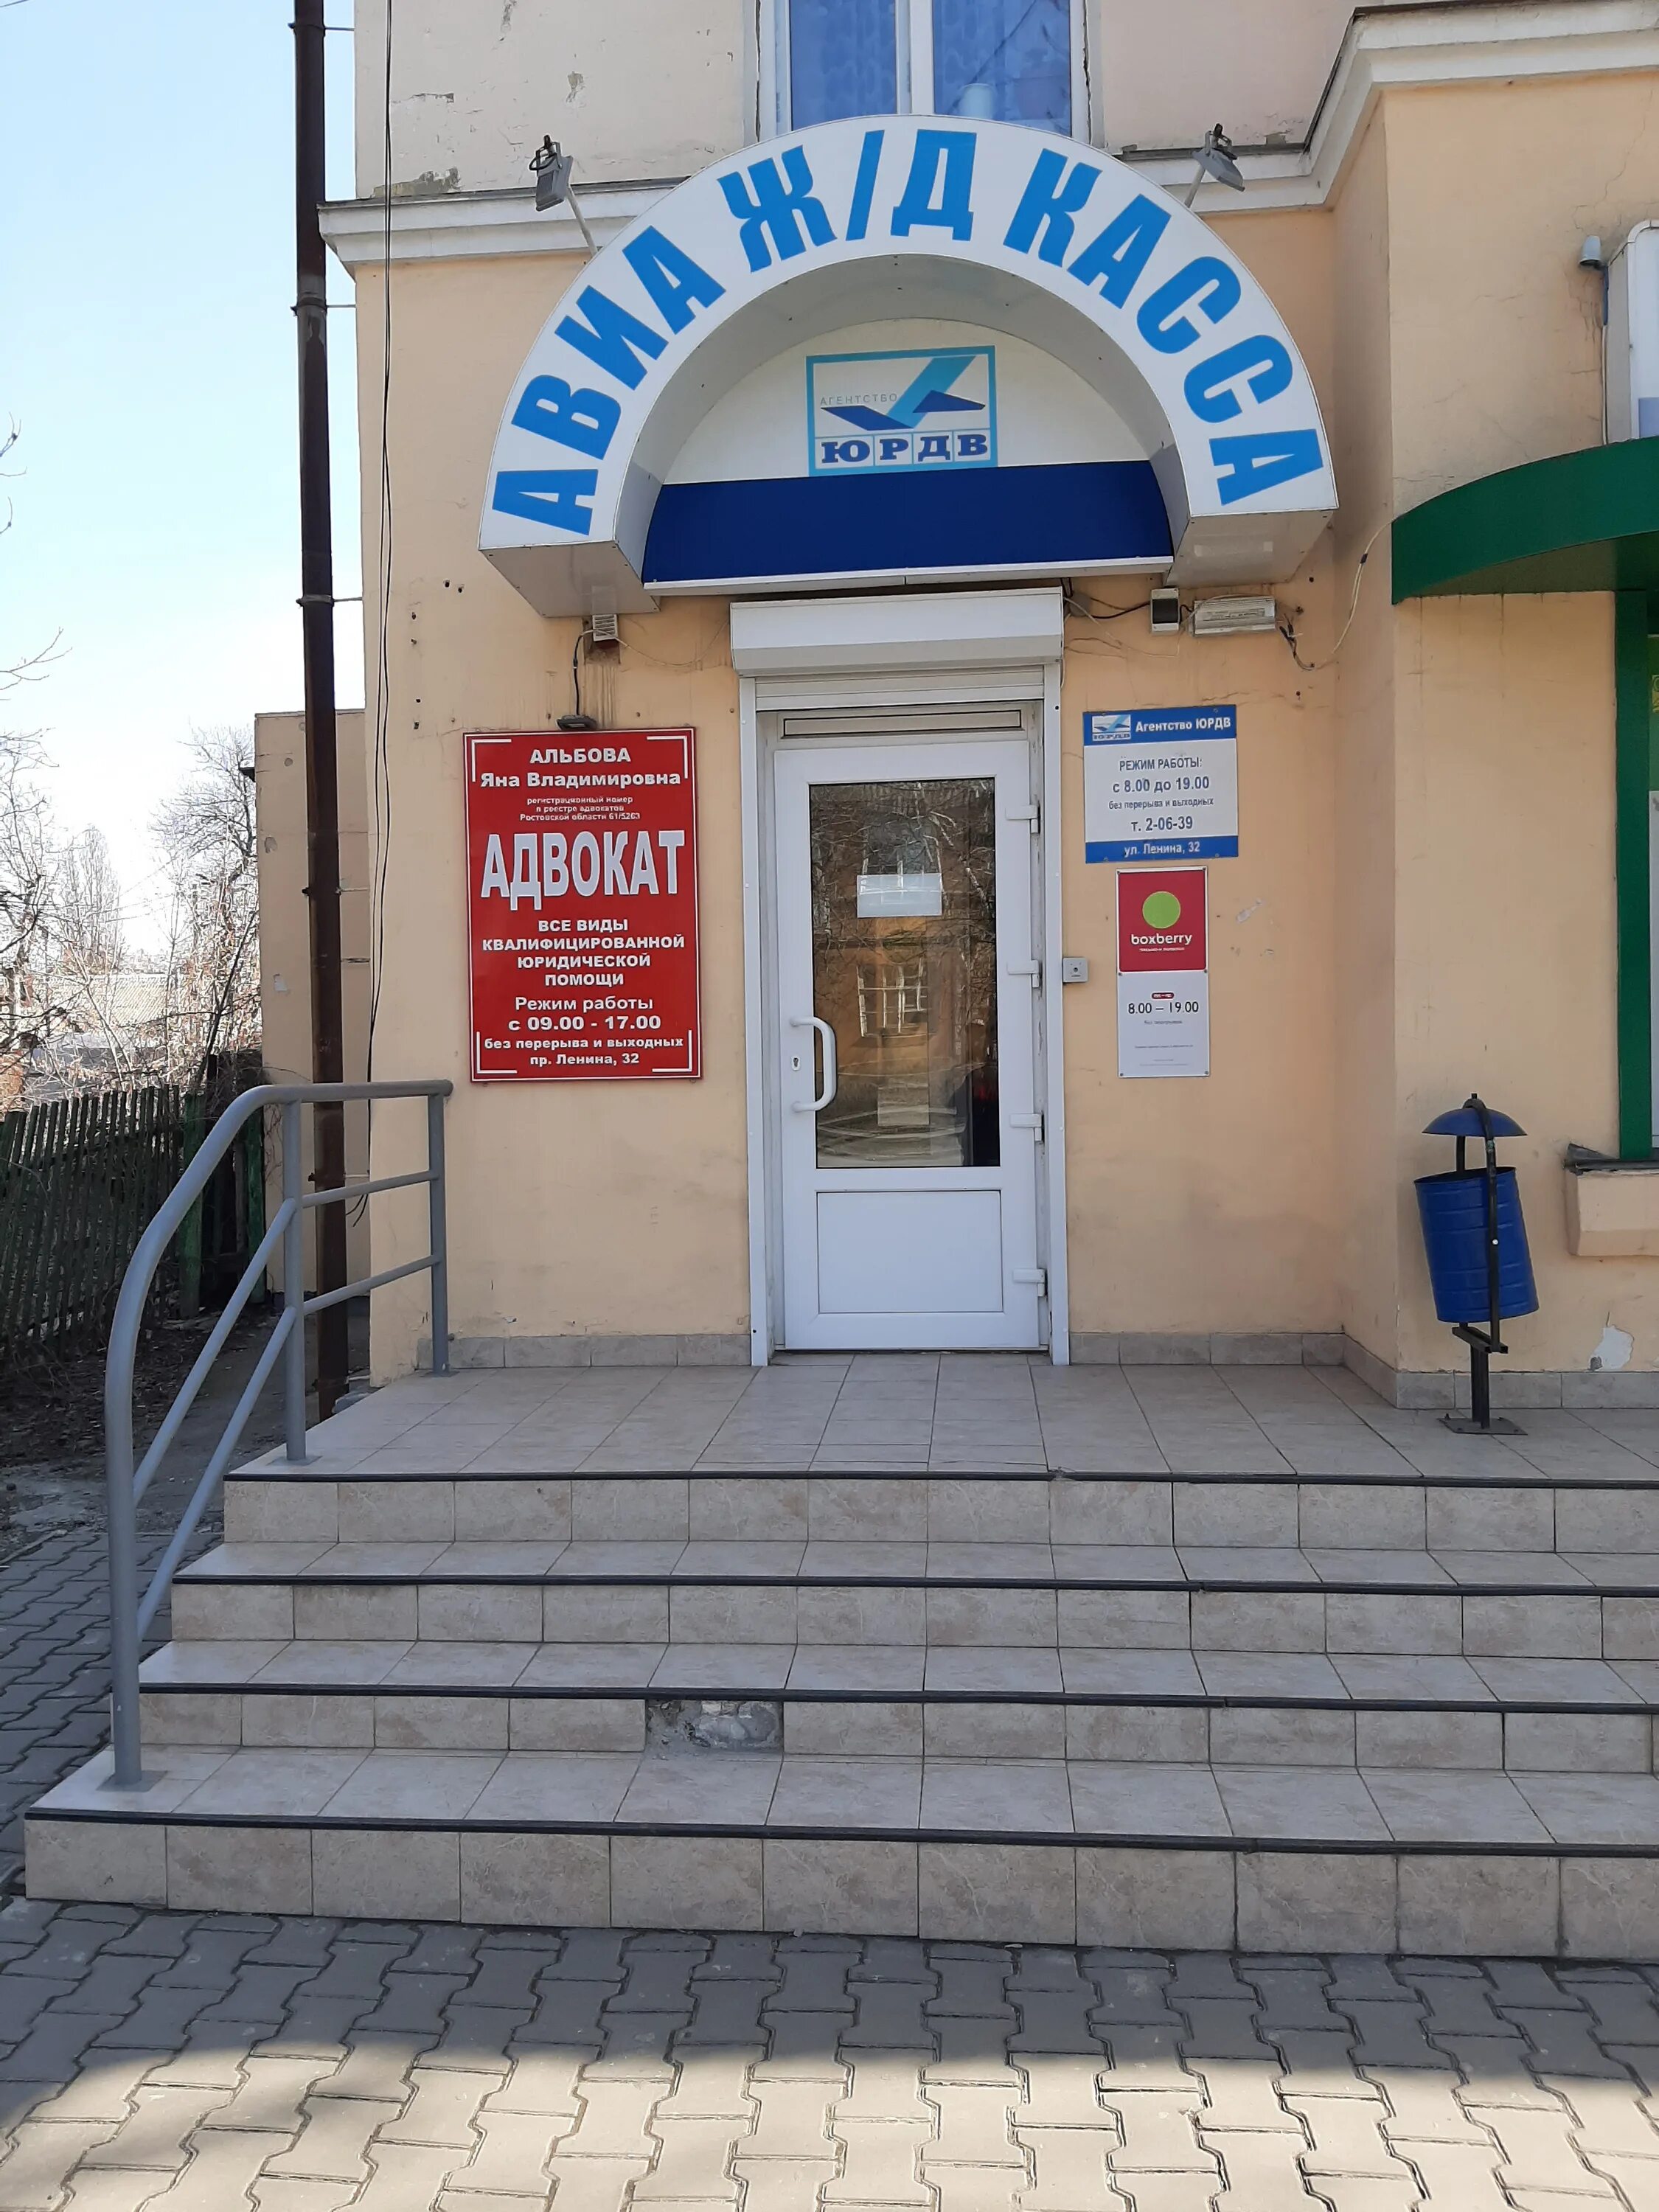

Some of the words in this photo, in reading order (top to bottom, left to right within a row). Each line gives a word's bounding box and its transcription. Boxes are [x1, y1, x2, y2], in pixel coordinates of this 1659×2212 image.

[492, 226, 726, 535] АВИА
[717, 128, 977, 274] Ж/Д
[1003, 147, 1324, 506] КАССА
[821, 434, 988, 463] ЮРДВ
[1135, 720, 1192, 733] Агентство
[1195, 717, 1231, 731] ЮРДВ
[529, 748, 631, 764] АЛЬБОВА
[1119, 759, 1155, 771] РЕЖИМ
[1158, 757, 1202, 769] РАБОТЫ:
[481, 772, 521, 787] Яна
[526, 772, 681, 789] Владимировна
[1113, 783, 1120, 793] с
[1124, 779, 1150, 793] 8.00
[1153, 780, 1171, 793] до
[1176, 776, 1209, 790] 19.00
[527, 796, 604, 805] регистрационный
[606, 796, 633, 804] номер
[1108, 801, 1122, 810] без
[1124, 800, 1163, 810] перерыва
[1172, 798, 1214, 807] выходных
[520, 813, 570, 821] Ростовской
[571, 812, 607, 821] области
[1131, 821, 1141, 832] т.
[1145, 815, 1193, 831] 2-06-39
[1124, 846, 1140, 858] ул.
[1143, 843, 1185, 855] Ленина,
[1188, 841, 1200, 852] 32
[481, 830, 685, 911] АДВОКАТ
[538, 919, 571, 932] ВСЕ
[577, 919, 628, 933] ВИДЫ
[482, 933, 685, 951] КВАЛИФИЦИРОВАННОЙ
[1131, 933, 1192, 945] boxberry
[518, 952, 651, 970] ЮРИДИЧЕСКОЙ
[545, 973, 624, 987] ПОМОЩИ
[515, 997, 577, 1011] Режим
[582, 995, 653, 1013] работы
[1128, 1002, 1152, 1014] 8.00
[1169, 1001, 1199, 1013] 19.00
[508, 1020, 521, 1031] с
[527, 1016, 584, 1031] 09.00
[605, 1015, 661, 1030] 17.00
[484, 1037, 511, 1048] без
[515, 1039, 588, 1050] перерыва
[594, 1039, 602, 1048] и
[607, 1037, 684, 1049] выходных
[530, 1056, 552, 1067] пр.
[555, 1054, 617, 1066] Ленина,
[622, 1053, 640, 1064] 32
